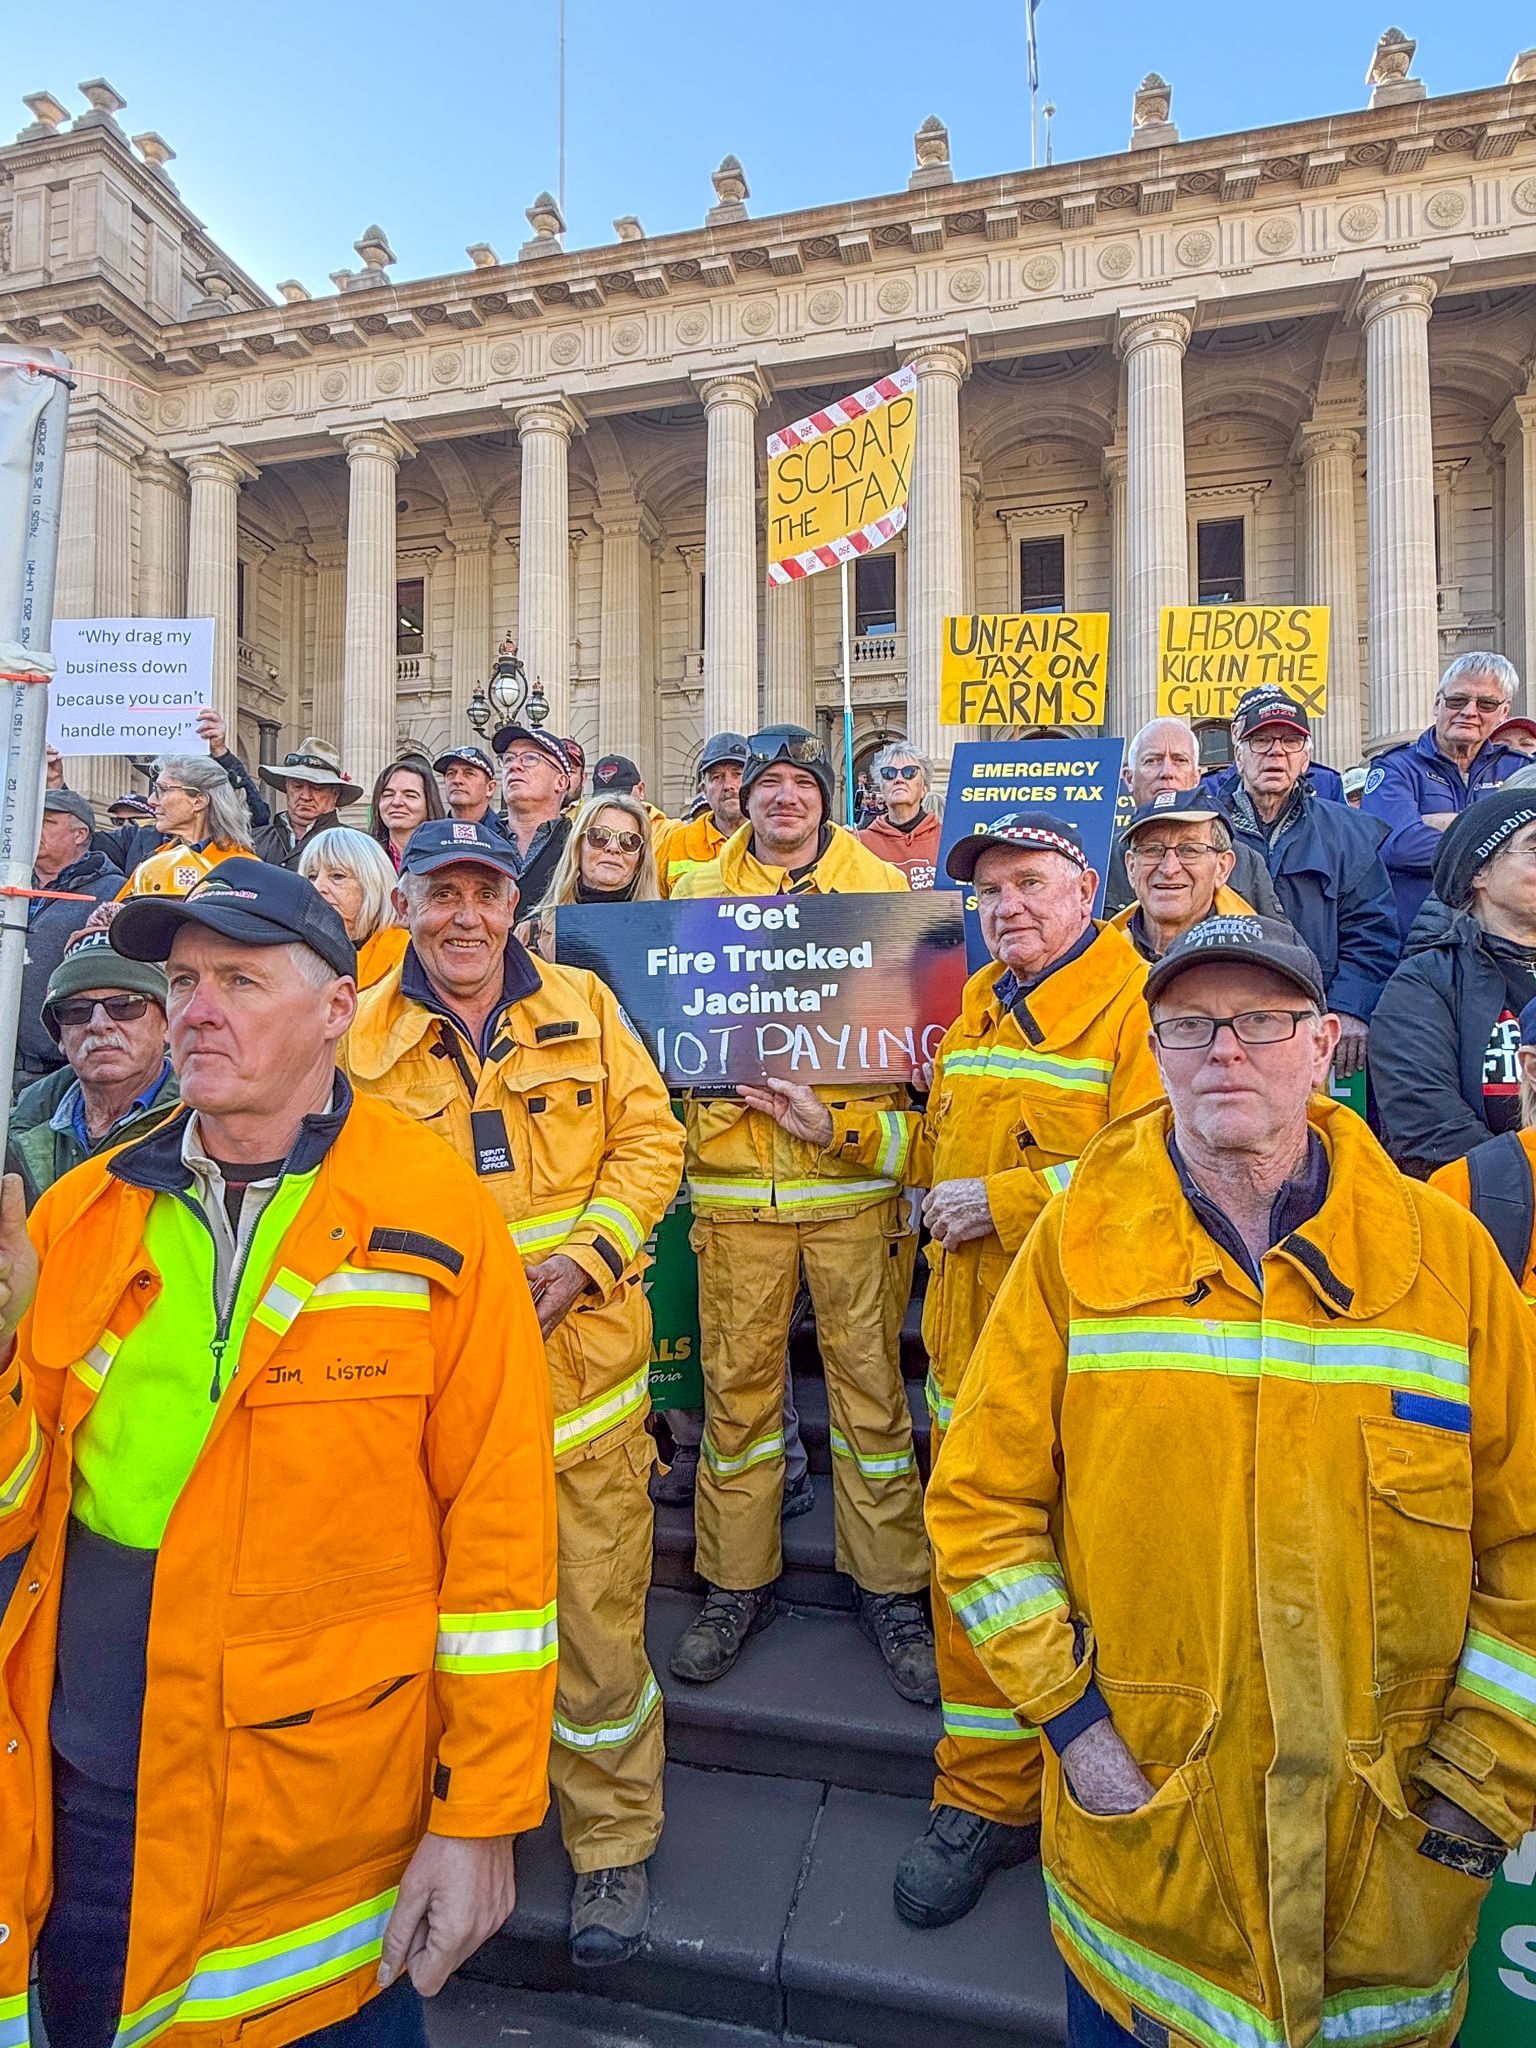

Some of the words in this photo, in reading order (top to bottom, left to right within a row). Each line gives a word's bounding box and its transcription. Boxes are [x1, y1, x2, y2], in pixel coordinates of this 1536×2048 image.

[777, 397, 913, 505] SCRAP
[772, 506, 820, 544] THE
[831, 444, 910, 527] TAX
[78, 629, 121, 646] “Why
[125, 629, 163, 645] drag
[166, 631, 192, 646] my
[950, 614, 1082, 656] UNFAIR
[1166, 609, 1312, 653] LABOR'S
[66, 660, 137, 674] business
[141, 660, 188, 674] down
[977, 654, 1034, 679] TAX
[1049, 653, 1099, 679] ON
[1256, 654, 1318, 683] THE
[56, 693, 125, 707] because
[129, 694, 159, 707] you
[162, 691, 204, 704] can’t
[959, 680, 1097, 724] FARMS
[61, 723, 115, 738] handle
[120, 723, 192, 739] money!”
[972, 761, 1100, 779] EMERGENCY
[960, 786, 1057, 802] SERVICES
[1064, 786, 1103, 801] TAX
[647, 944, 715, 976] Fire
[723, 942, 872, 972] Trucked
[682, 984, 838, 1016] Jacinta”
[479, 1148, 506, 1158] DEPUTY
[482, 1156, 506, 1164] GROUP
[481, 1162, 510, 1171] OFFICER
